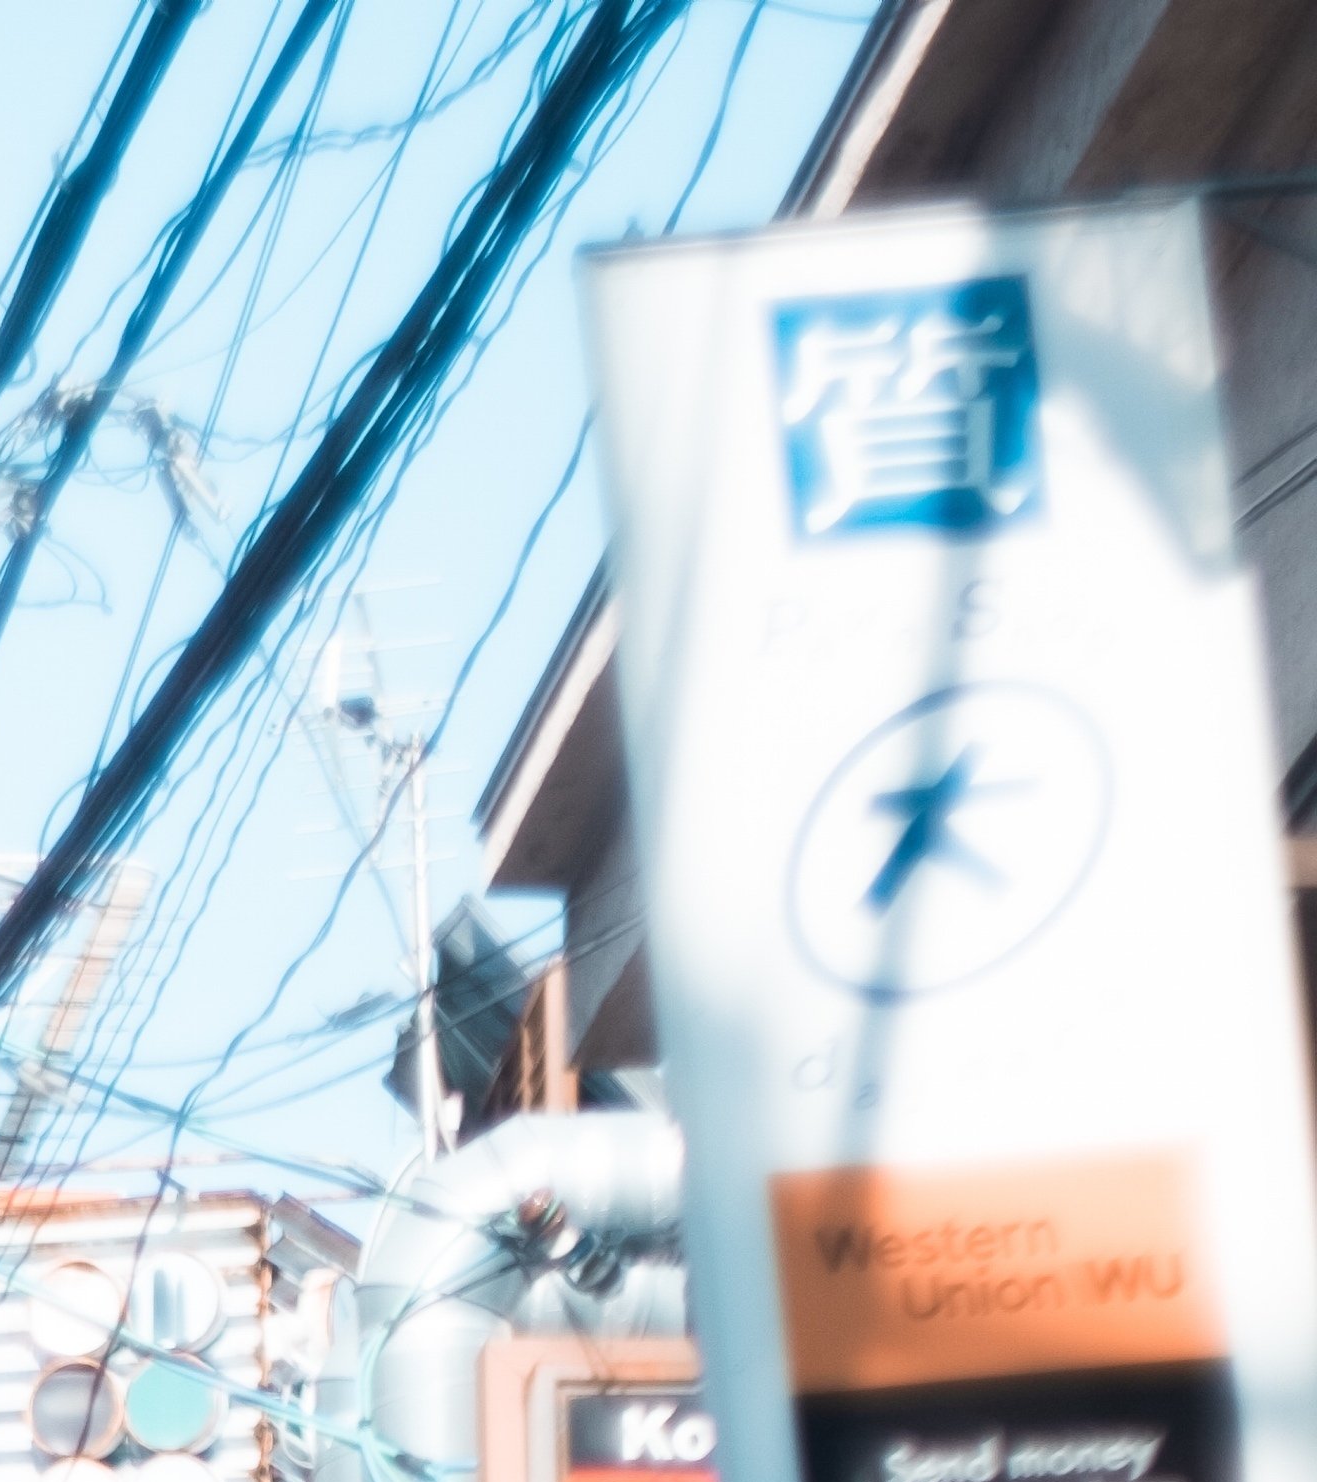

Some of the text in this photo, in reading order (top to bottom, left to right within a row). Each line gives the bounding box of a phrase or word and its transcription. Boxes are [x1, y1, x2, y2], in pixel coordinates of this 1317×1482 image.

[783, 303, 1036, 530] 質
[816, 1217, 1061, 1274] Western
[901, 1252, 1187, 1320] Union WU
[1008, 1431, 1168, 1482] money
